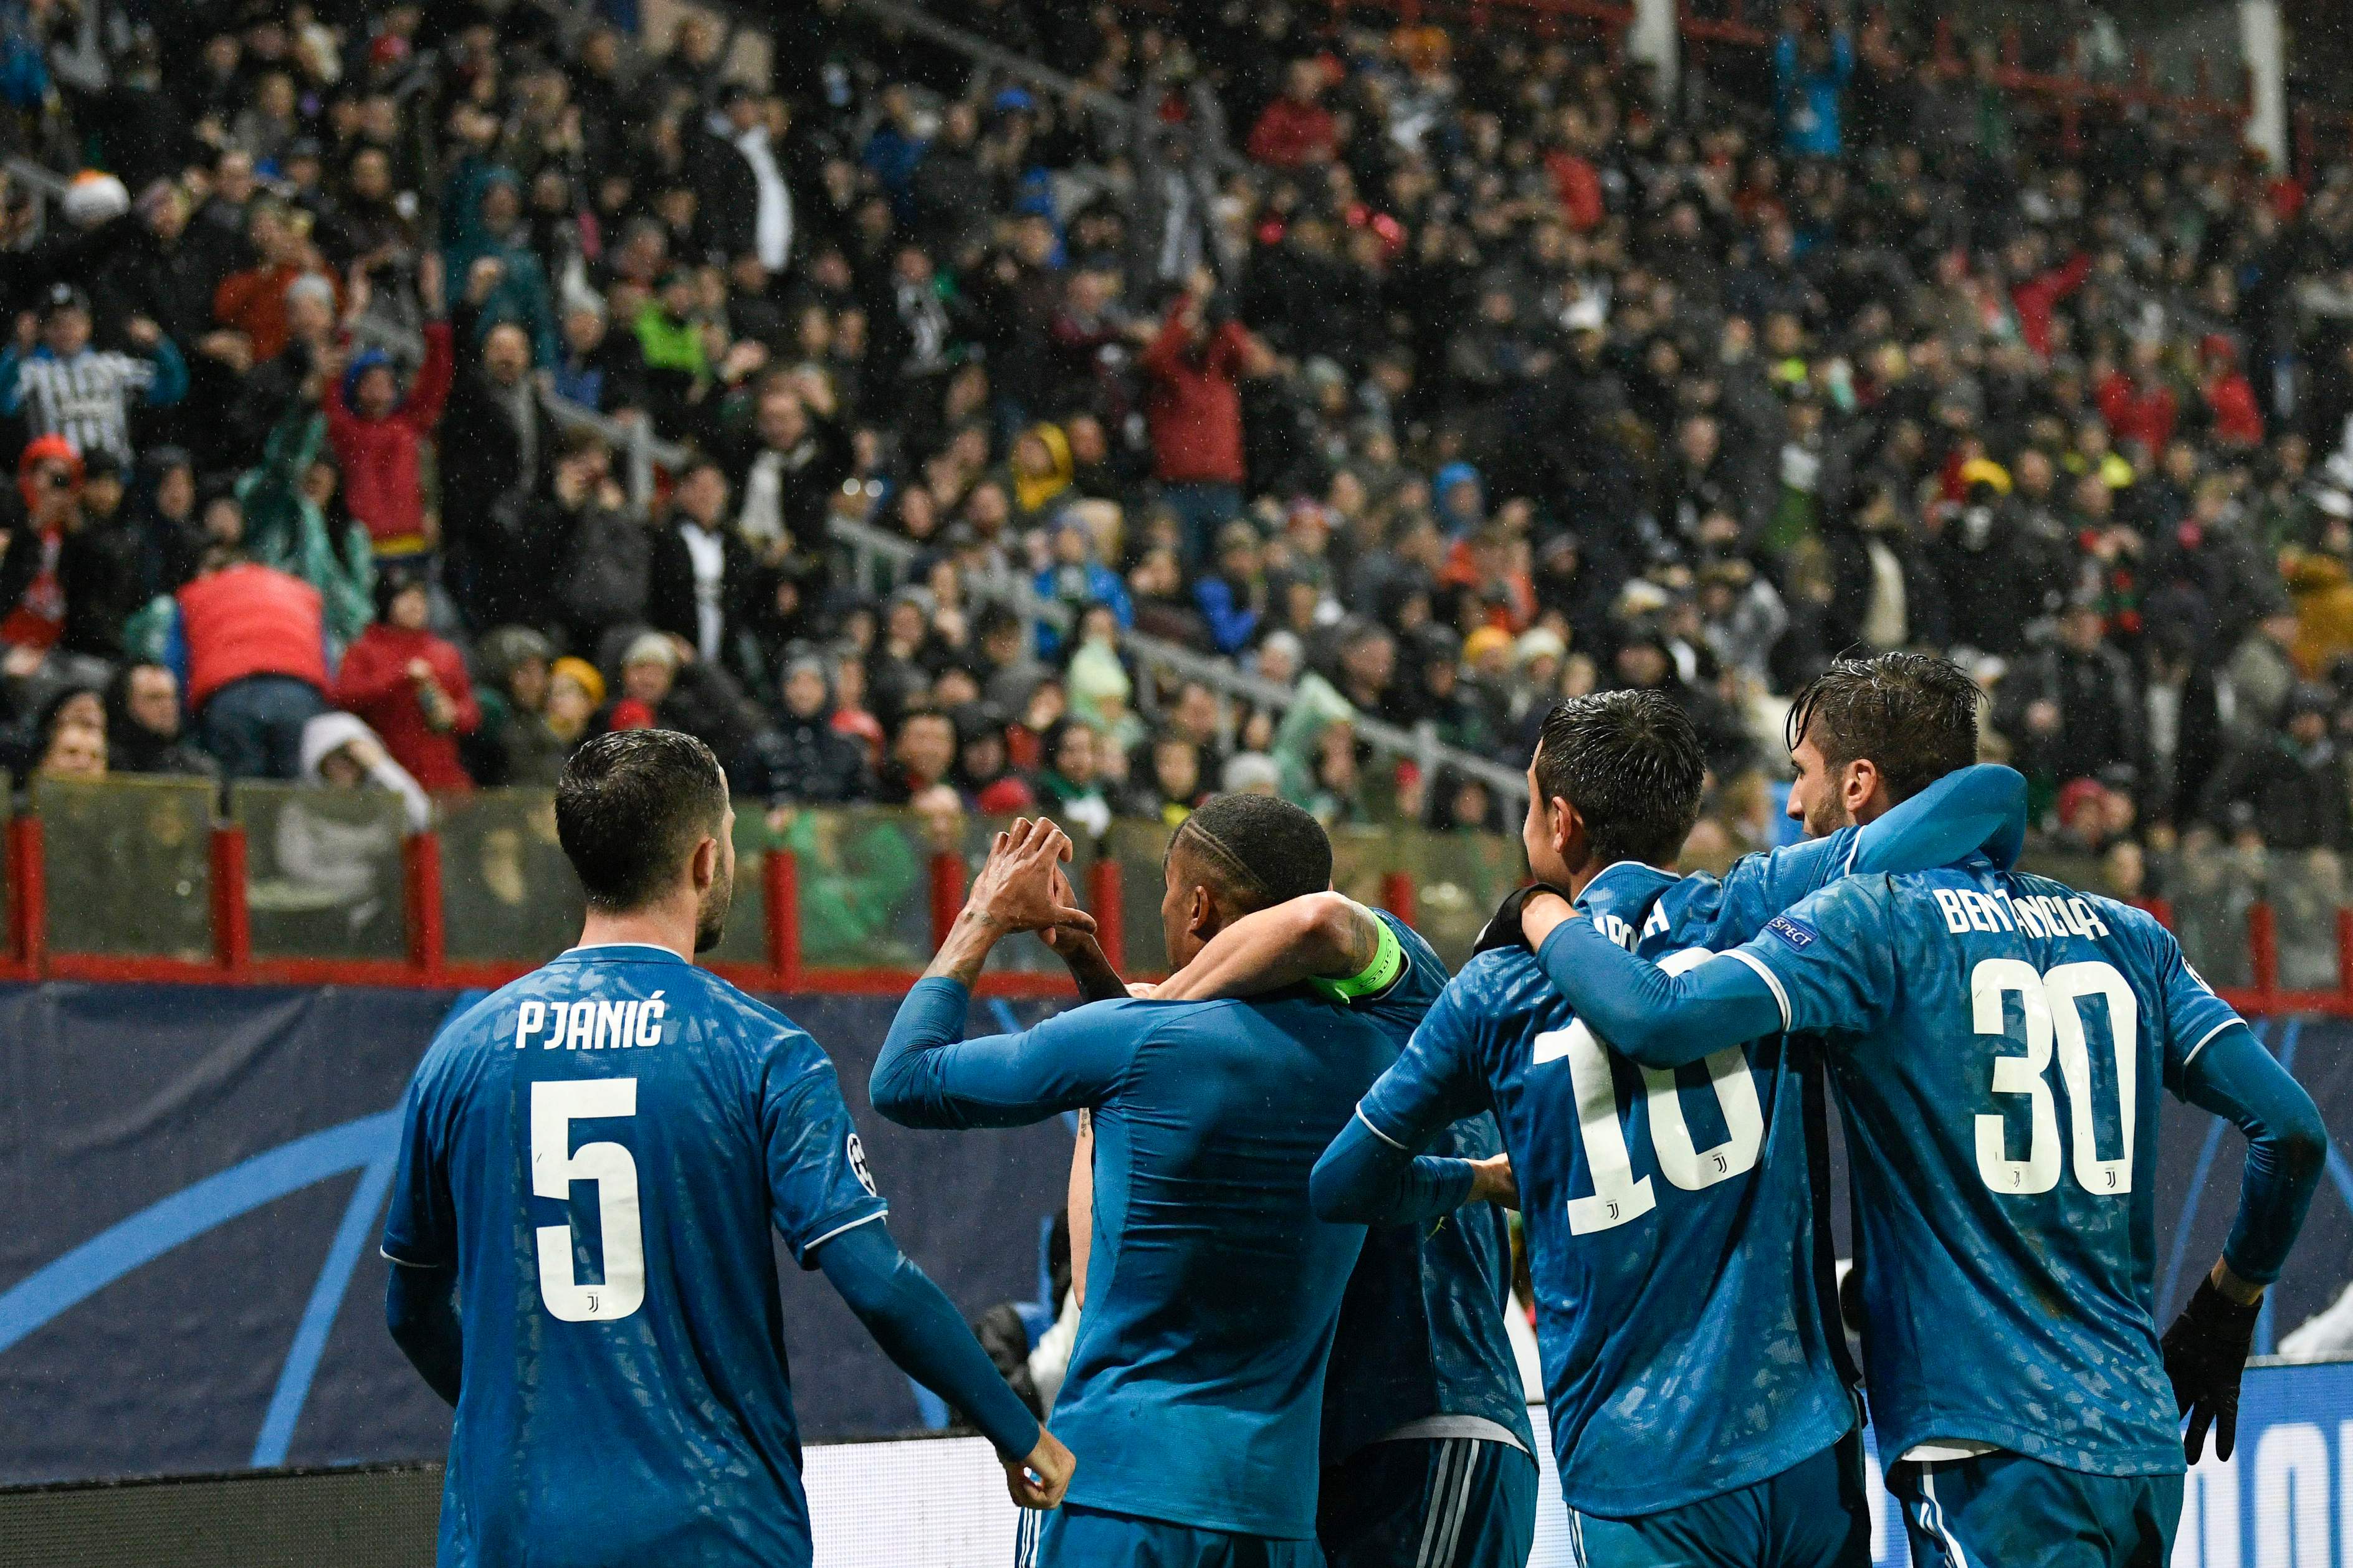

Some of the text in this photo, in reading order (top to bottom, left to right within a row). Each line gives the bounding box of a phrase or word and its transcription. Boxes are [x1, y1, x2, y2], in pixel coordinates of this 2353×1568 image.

[1359, 931, 1393, 989] ESPECT
[1767, 918, 1812, 946] ESPECT
[515, 990, 666, 1050] PJANIĆ
[1532, 946, 1767, 1236] 10
[1970, 958, 2137, 1194] 30
[530, 1078, 644, 1322] 5
